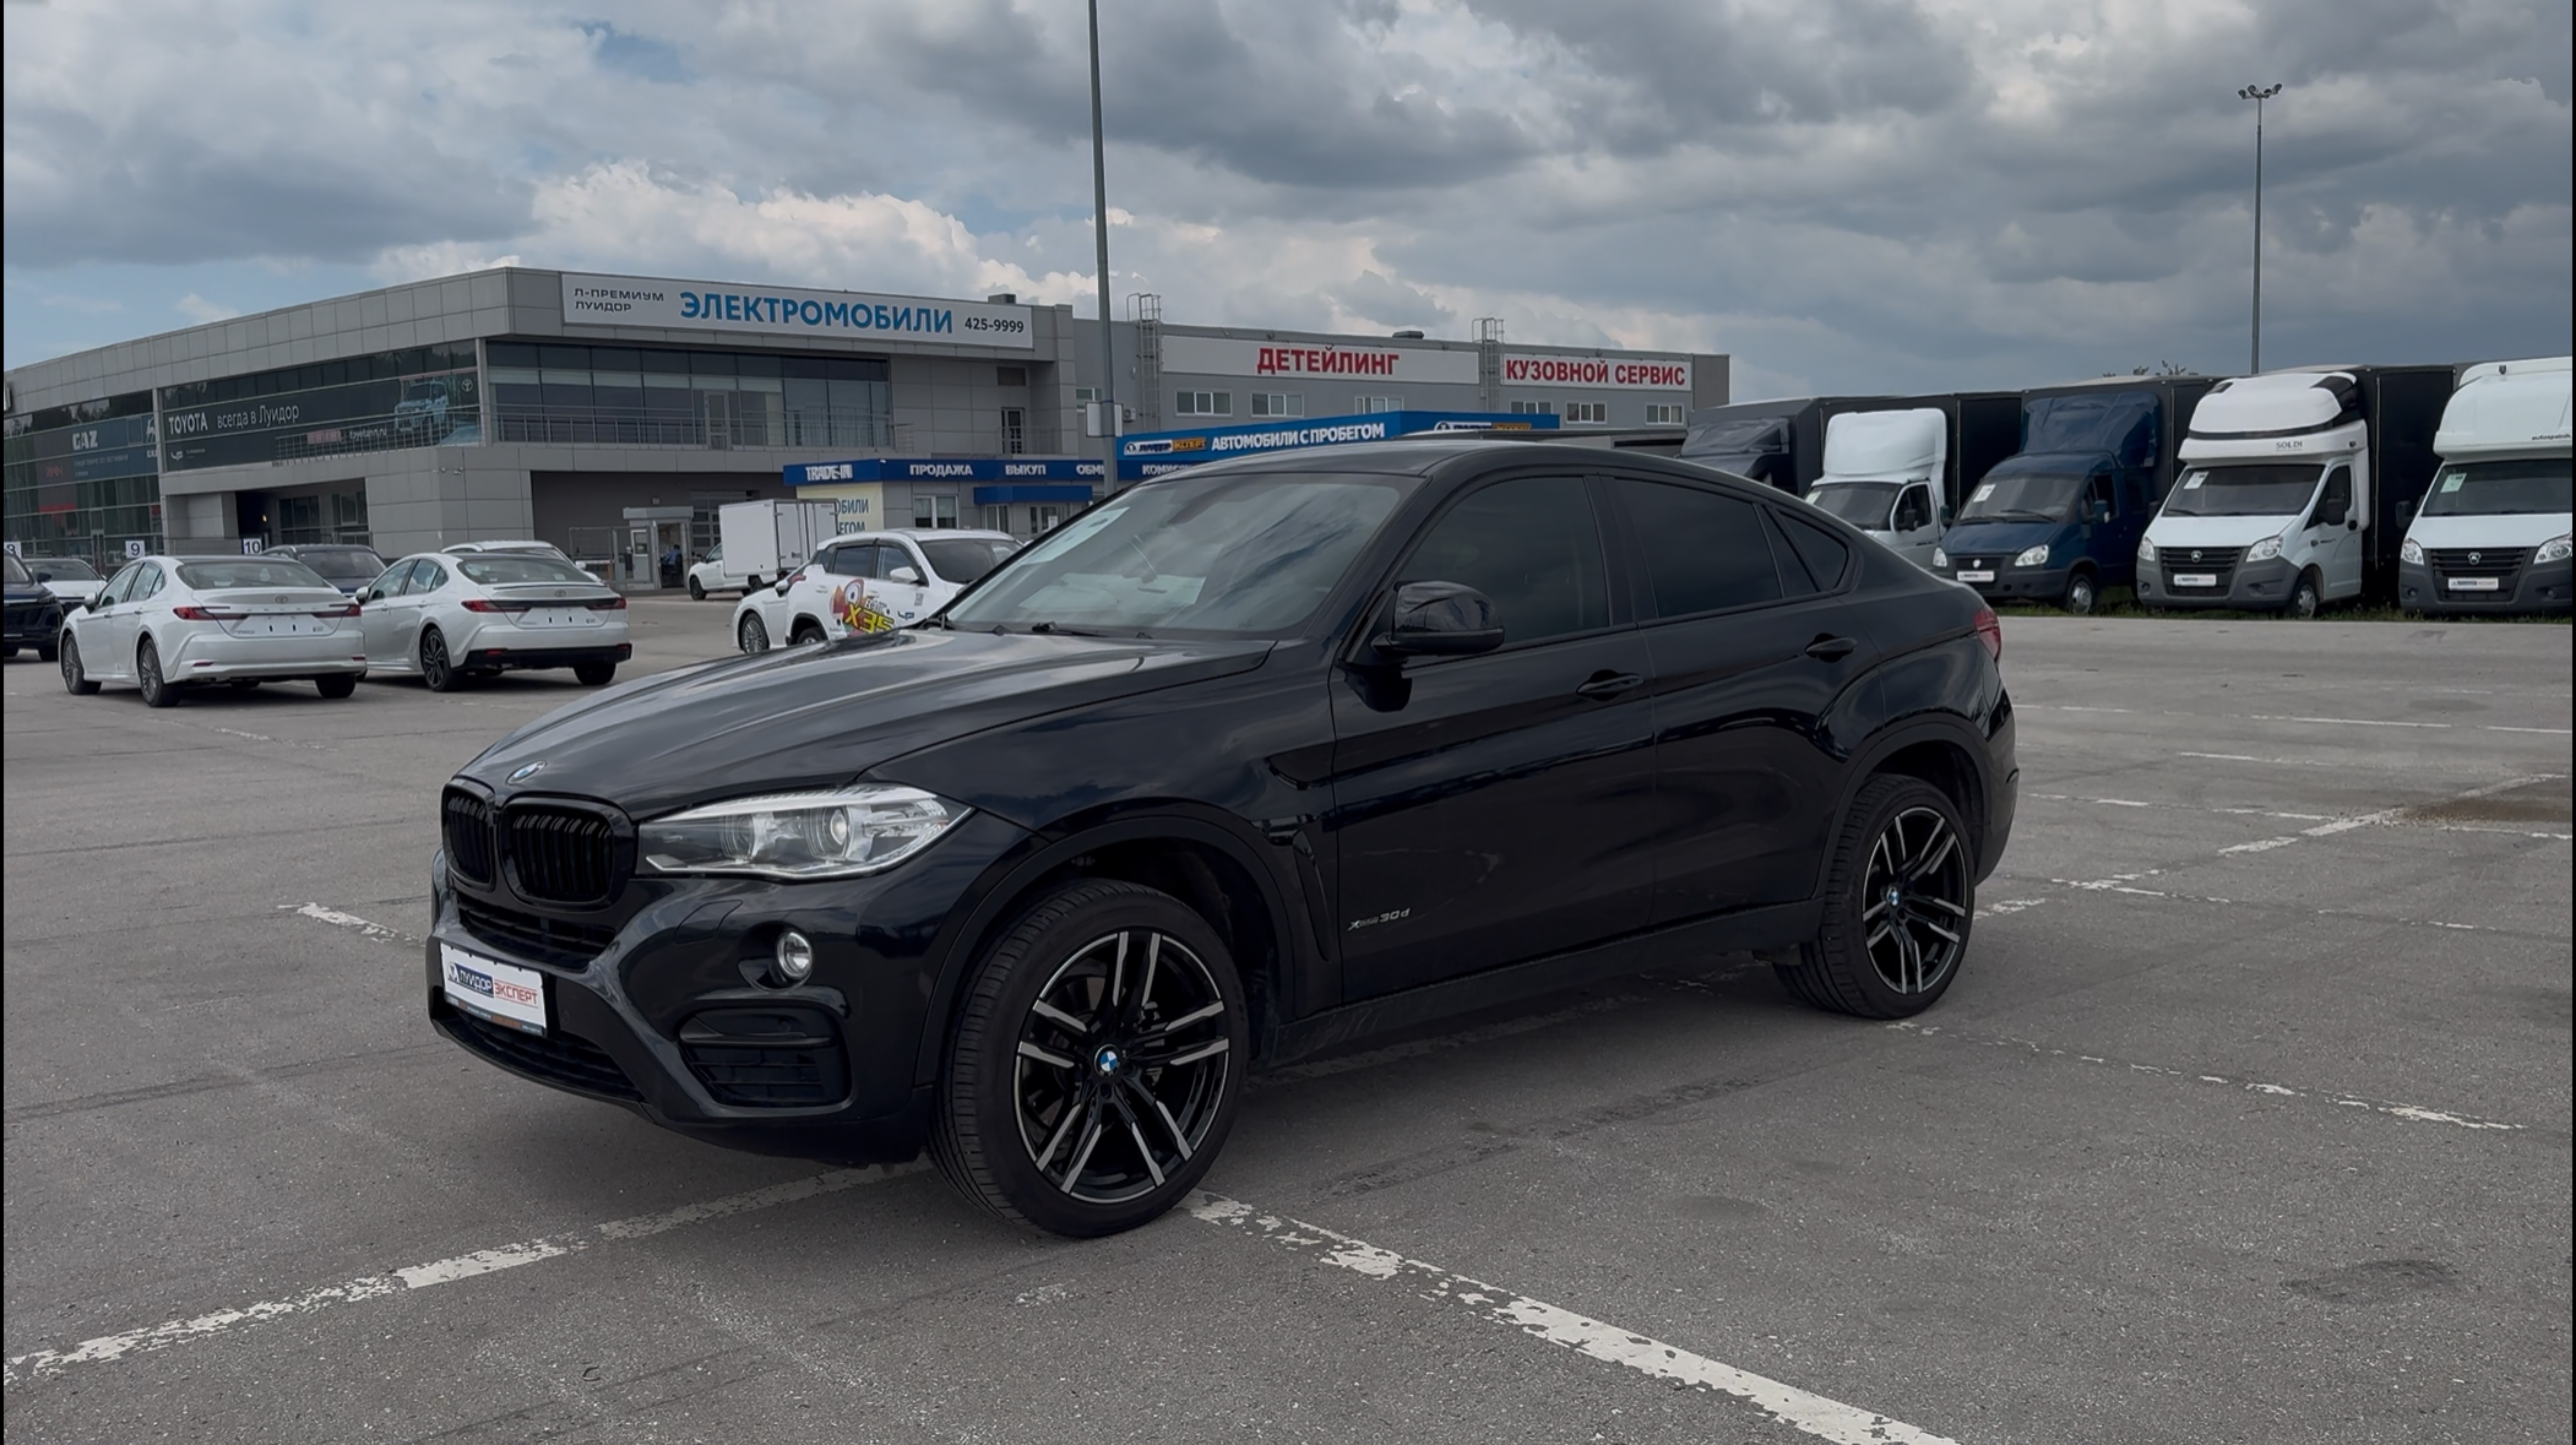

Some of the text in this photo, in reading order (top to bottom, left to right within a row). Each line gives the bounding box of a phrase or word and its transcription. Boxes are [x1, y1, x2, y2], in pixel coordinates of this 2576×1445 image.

[574, 288, 664, 302] Л-ПРЕМИУМ
[575, 301, 632, 312] ЛУИДОР
[680, 291, 953, 333] ЭЛЕКТРОМОБИЛИ
[964, 317, 1025, 333] 425-9999
[1257, 344, 1400, 375] ДЕТЕЙЛИНГ
[1506, 359, 1685, 386] КУЗОВНОЙ СЕРВИС
[169, 412, 208, 435] TOYOTA
[217, 405, 300, 429] всегда в Луидор
[72, 430, 98, 450] GAZ
[1212, 422, 1385, 451] АВТОМОБИЛИ С ПРОБЕГОМ
[805, 464, 853, 481] TRADE-IN
[909, 465, 973, 477] ПРОДАЖА
[1005, 465, 1046, 476] ВЫКУП
[130, 543, 140, 556] 9
[245, 540, 261, 554] 10
[843, 603, 896, 633] X35
[495, 983, 538, 1005] ЭКСПЕРТ
